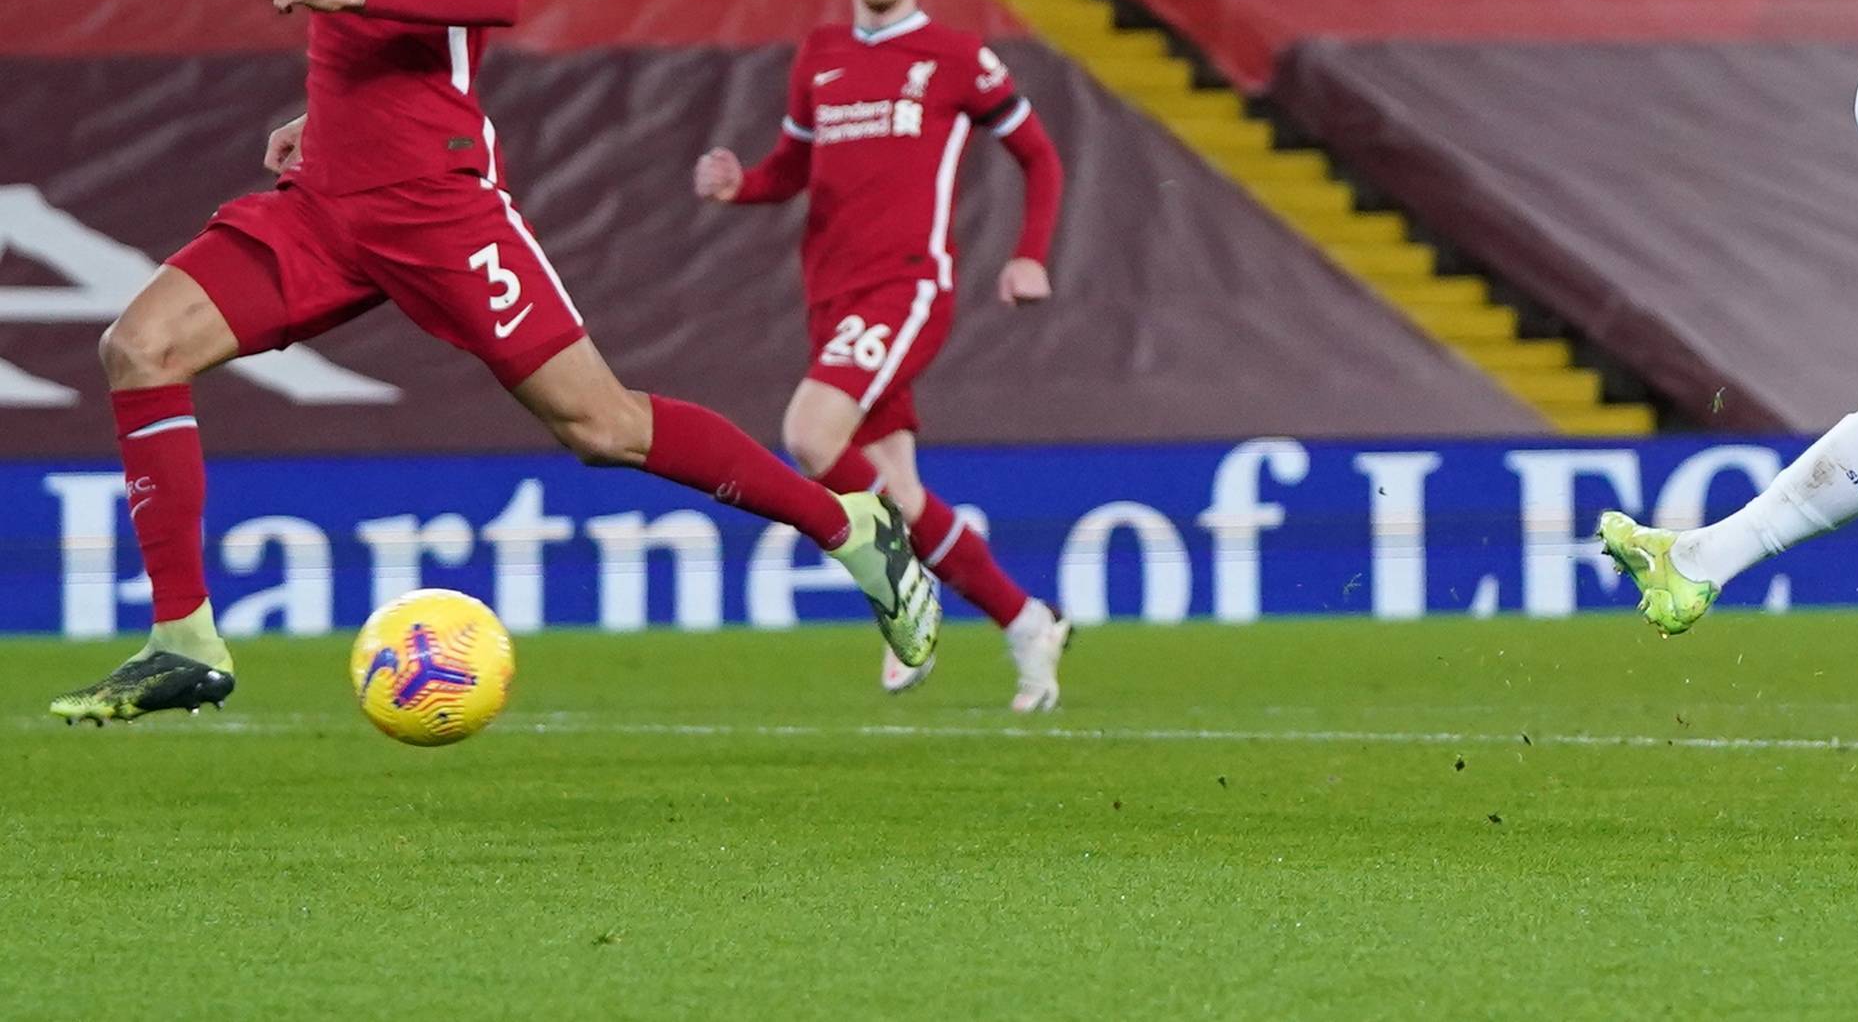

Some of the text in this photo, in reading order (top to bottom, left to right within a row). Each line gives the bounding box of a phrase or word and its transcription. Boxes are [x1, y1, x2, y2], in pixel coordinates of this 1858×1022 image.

[468, 241, 521, 312] 3
[818, 314, 892, 371] 26
[1057, 437, 1310, 625] of
[1354, 443, 1790, 623] LFC
